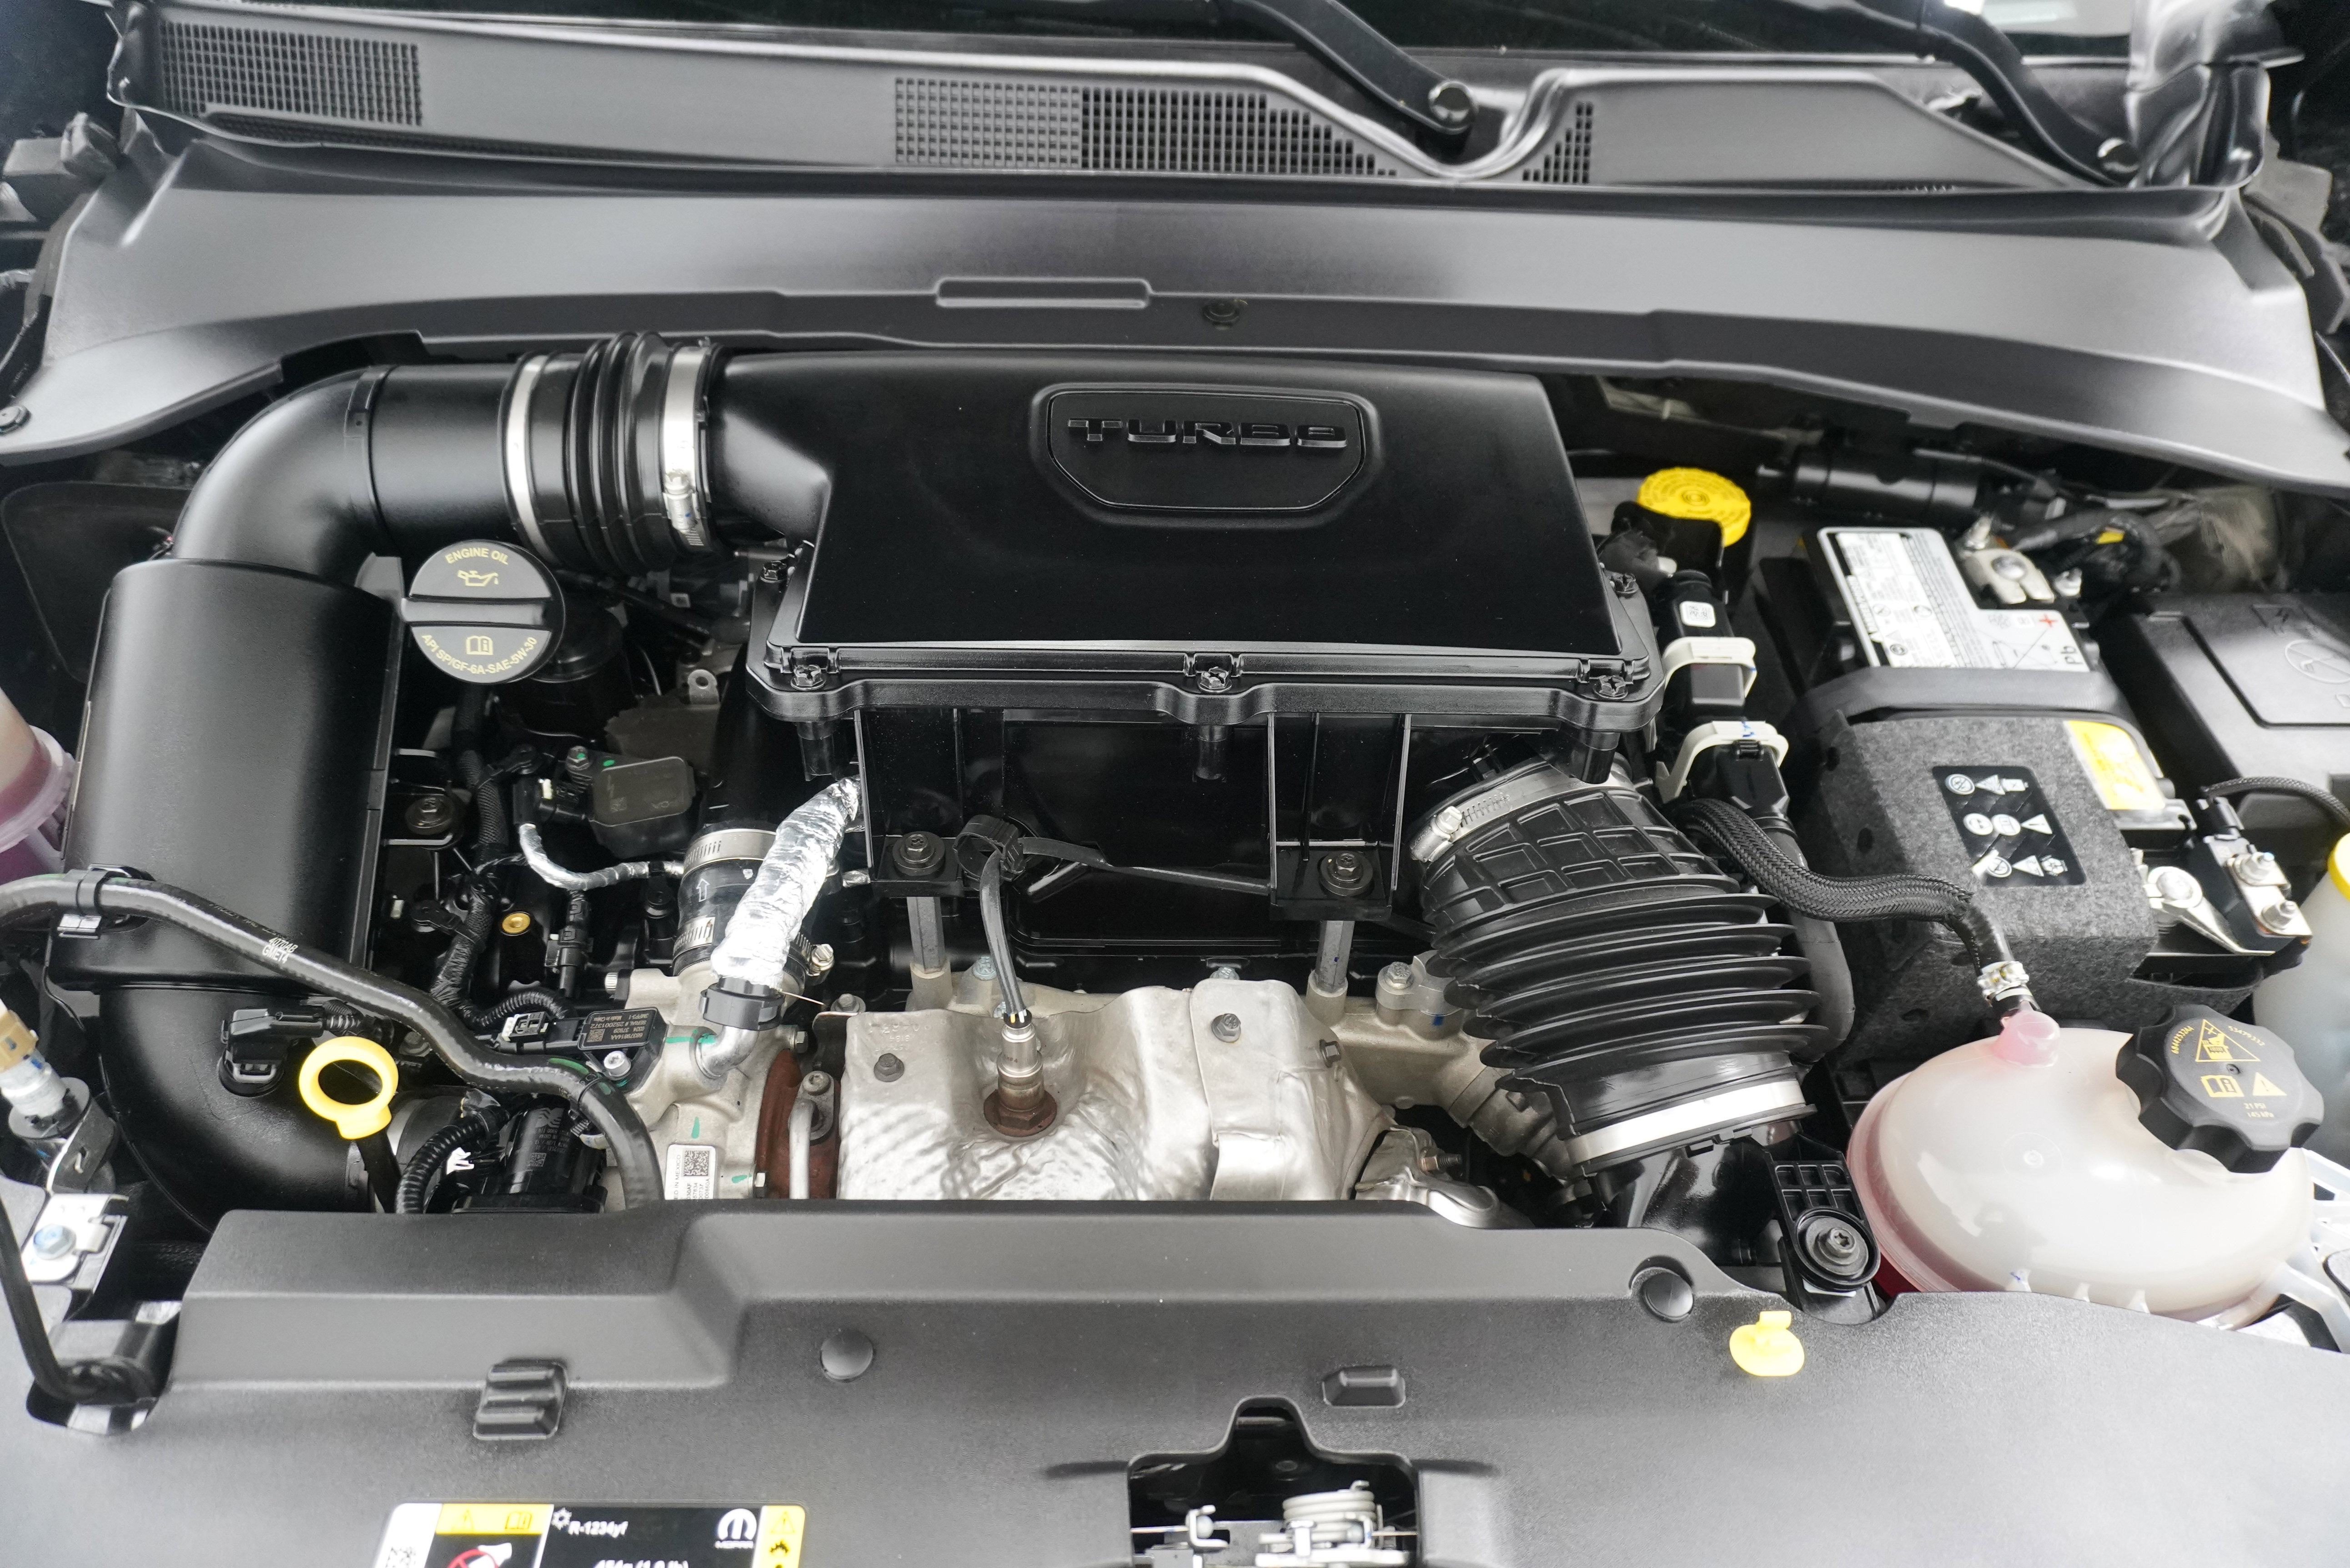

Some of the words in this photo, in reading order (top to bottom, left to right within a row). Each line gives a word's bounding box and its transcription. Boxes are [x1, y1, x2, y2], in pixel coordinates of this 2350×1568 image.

[1068, 418, 1347, 448] TURBO
[444, 547, 489, 565] ENGINE
[491, 550, 509, 565] OIL
[422, 634, 440, 653] API
[2060, 646, 2083, 665] Pb
[262, 945, 290, 964] GMET4
[269, 937, 299, 954] 4070AB
[2228, 1025, 2265, 1047] 53479332
[567, 1520, 629, 1538] R-1234yf
